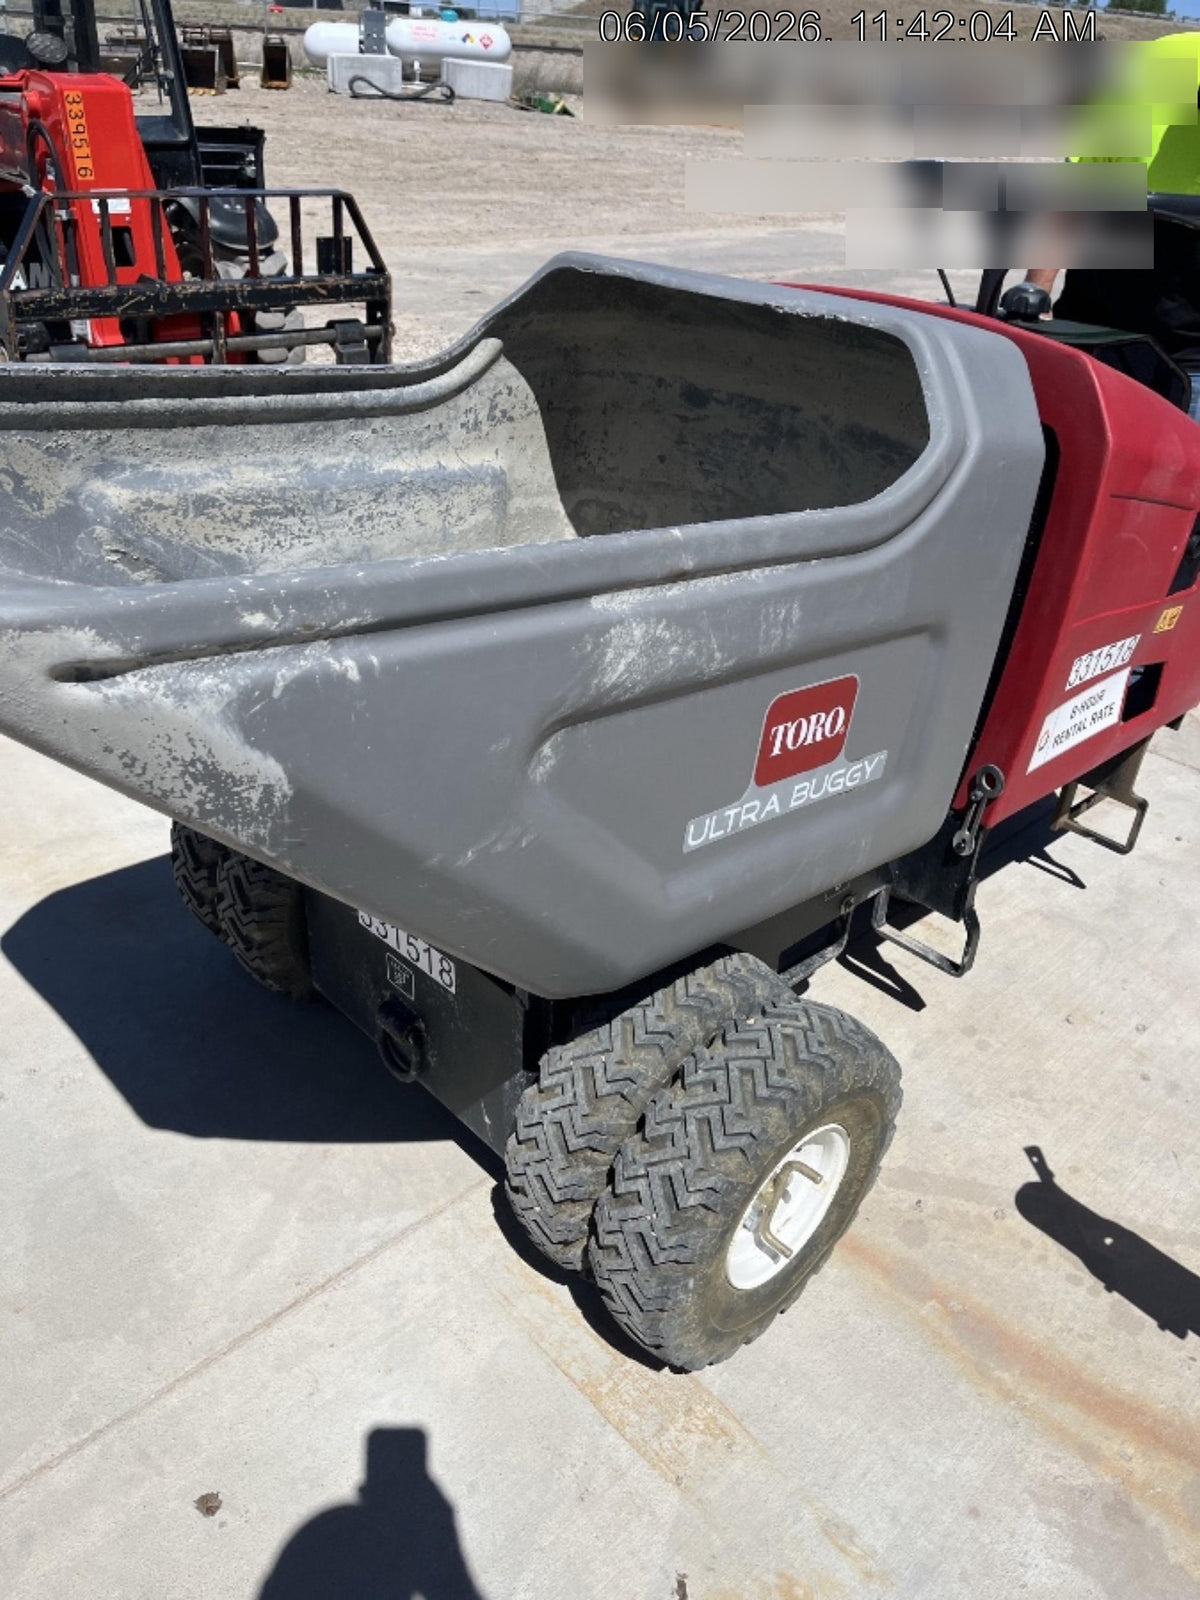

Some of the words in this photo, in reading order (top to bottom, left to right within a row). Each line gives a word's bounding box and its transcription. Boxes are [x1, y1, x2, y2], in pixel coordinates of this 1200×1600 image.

[65, 93, 93, 179] 339516
[1067, 634, 1139, 687] 331518
[769, 706, 846, 758] TORO
[687, 793, 780, 846] ULTRA
[789, 756, 880, 808] BUGGY
